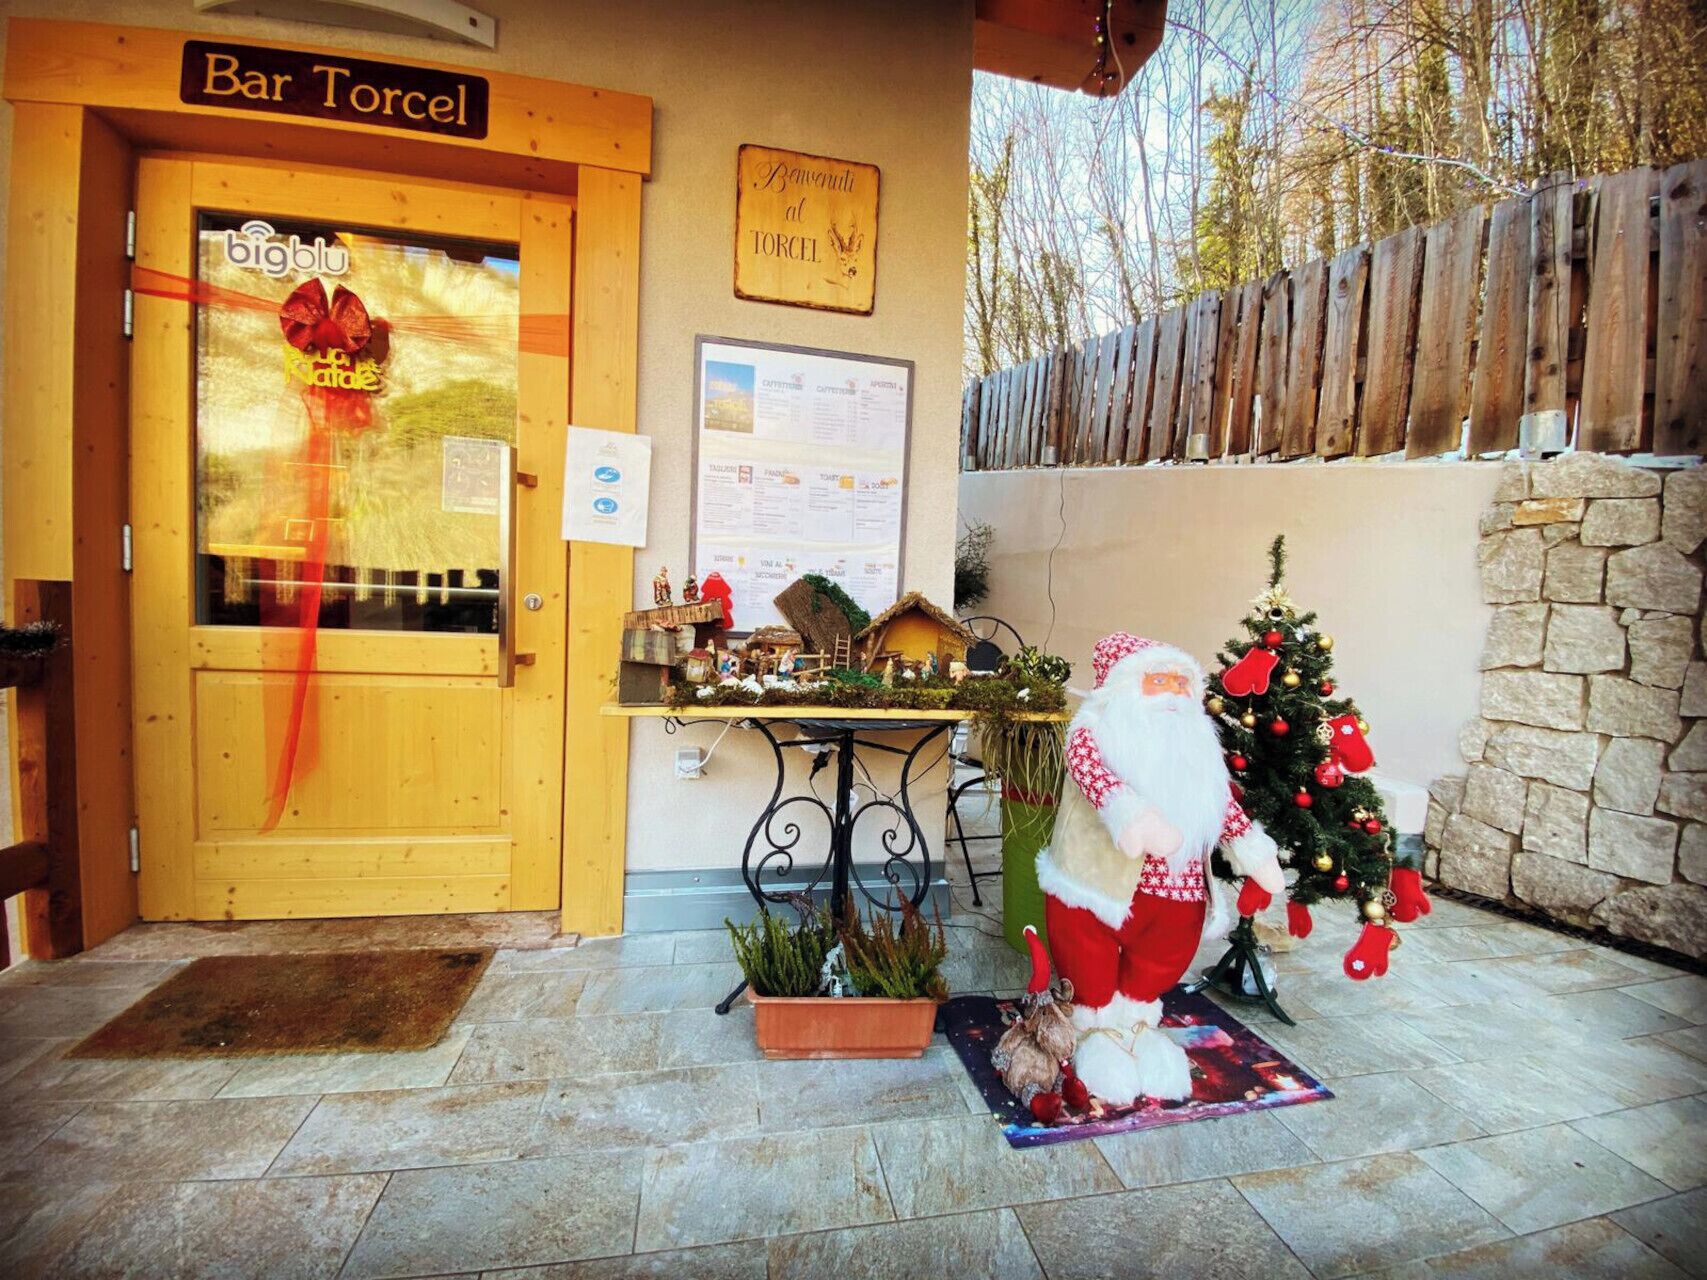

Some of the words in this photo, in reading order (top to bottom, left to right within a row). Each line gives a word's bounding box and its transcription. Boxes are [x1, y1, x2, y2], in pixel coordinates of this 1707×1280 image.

[202, 53, 292, 102] Bar
[312, 64, 467, 126] Torcel
[753, 160, 856, 194] Benvenuti
[784, 196, 807, 224] al
[226, 232, 347, 275] bigblu
[750, 229, 822, 264] TORCEL
